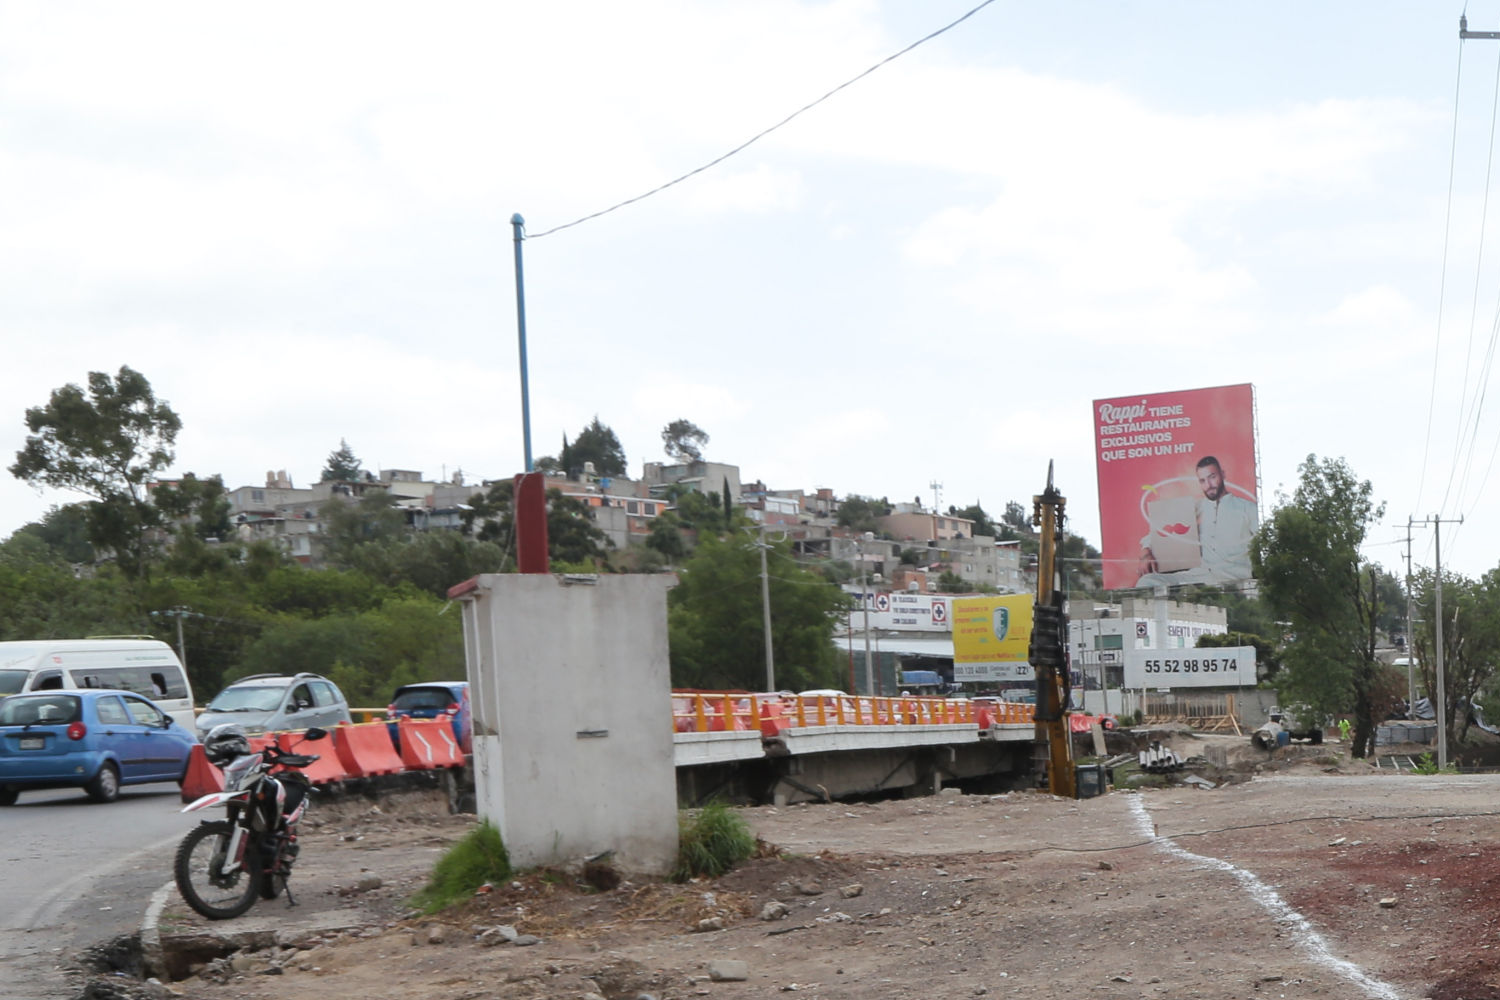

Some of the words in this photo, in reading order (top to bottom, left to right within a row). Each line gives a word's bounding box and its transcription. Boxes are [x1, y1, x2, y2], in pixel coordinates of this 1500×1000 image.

[1099, 399, 1147, 424] Rappi
[1149, 405, 1184, 417] TIENE
[1100, 417, 1191, 435] RESTAURANTES
[1101, 432, 1172, 448] EXCLUSIVOS
[1101, 449, 1126, 462] QUE
[1128, 447, 1152, 458] SON
[1154, 444, 1172, 456] UN
[1174, 442, 1195, 454] HIT
[1168, 625, 1191, 638] EMENTO
[1145, 660, 1160, 673] 55
[1164, 659, 1179, 673] 52
[1183, 659, 1199, 672] 98
[1202, 659, 1218, 672] 95
[1221, 658, 1237, 672] 74
